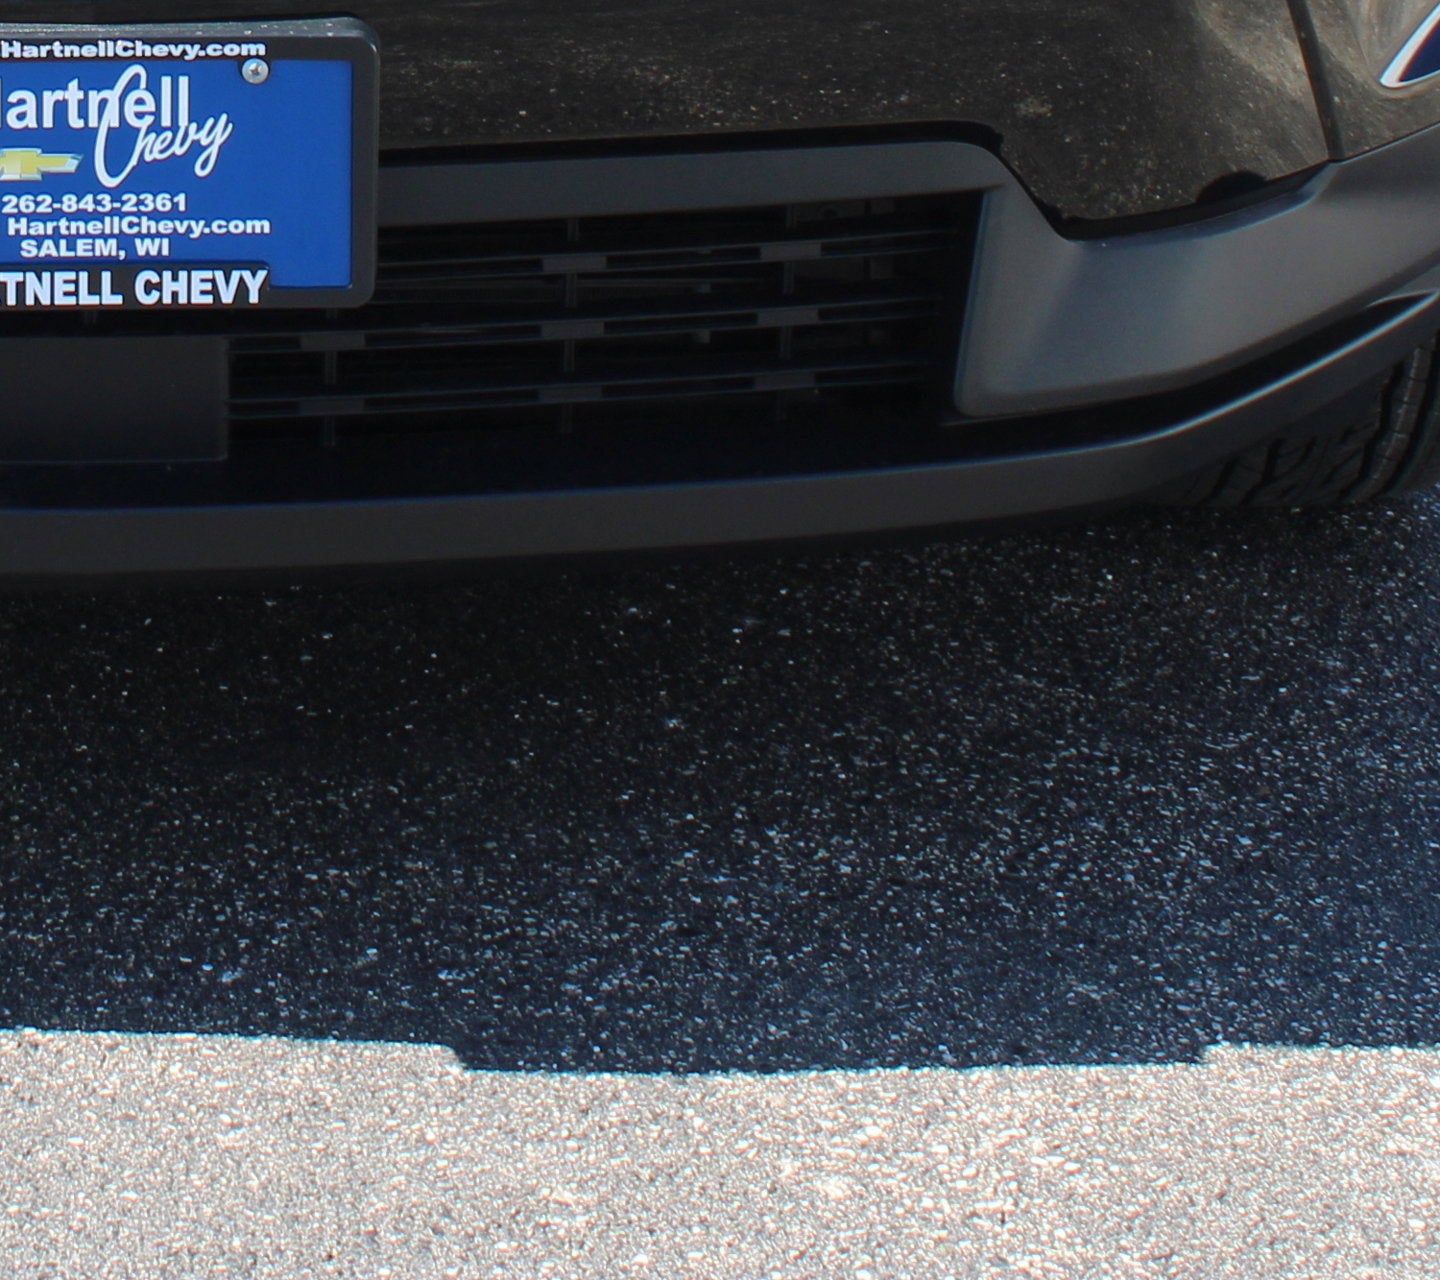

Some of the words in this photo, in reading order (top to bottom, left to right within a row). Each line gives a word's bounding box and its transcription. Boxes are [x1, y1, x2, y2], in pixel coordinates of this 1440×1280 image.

[94, 64, 233, 187] Chevy
[1, 193, 187, 214] 262-843-2361
[7, 216, 270, 238] HartnellChevy.com
[20, 238, 127, 261] SALEM,
[135, 238, 170, 257] WI
[135, 269, 269, 306] CHEVY
